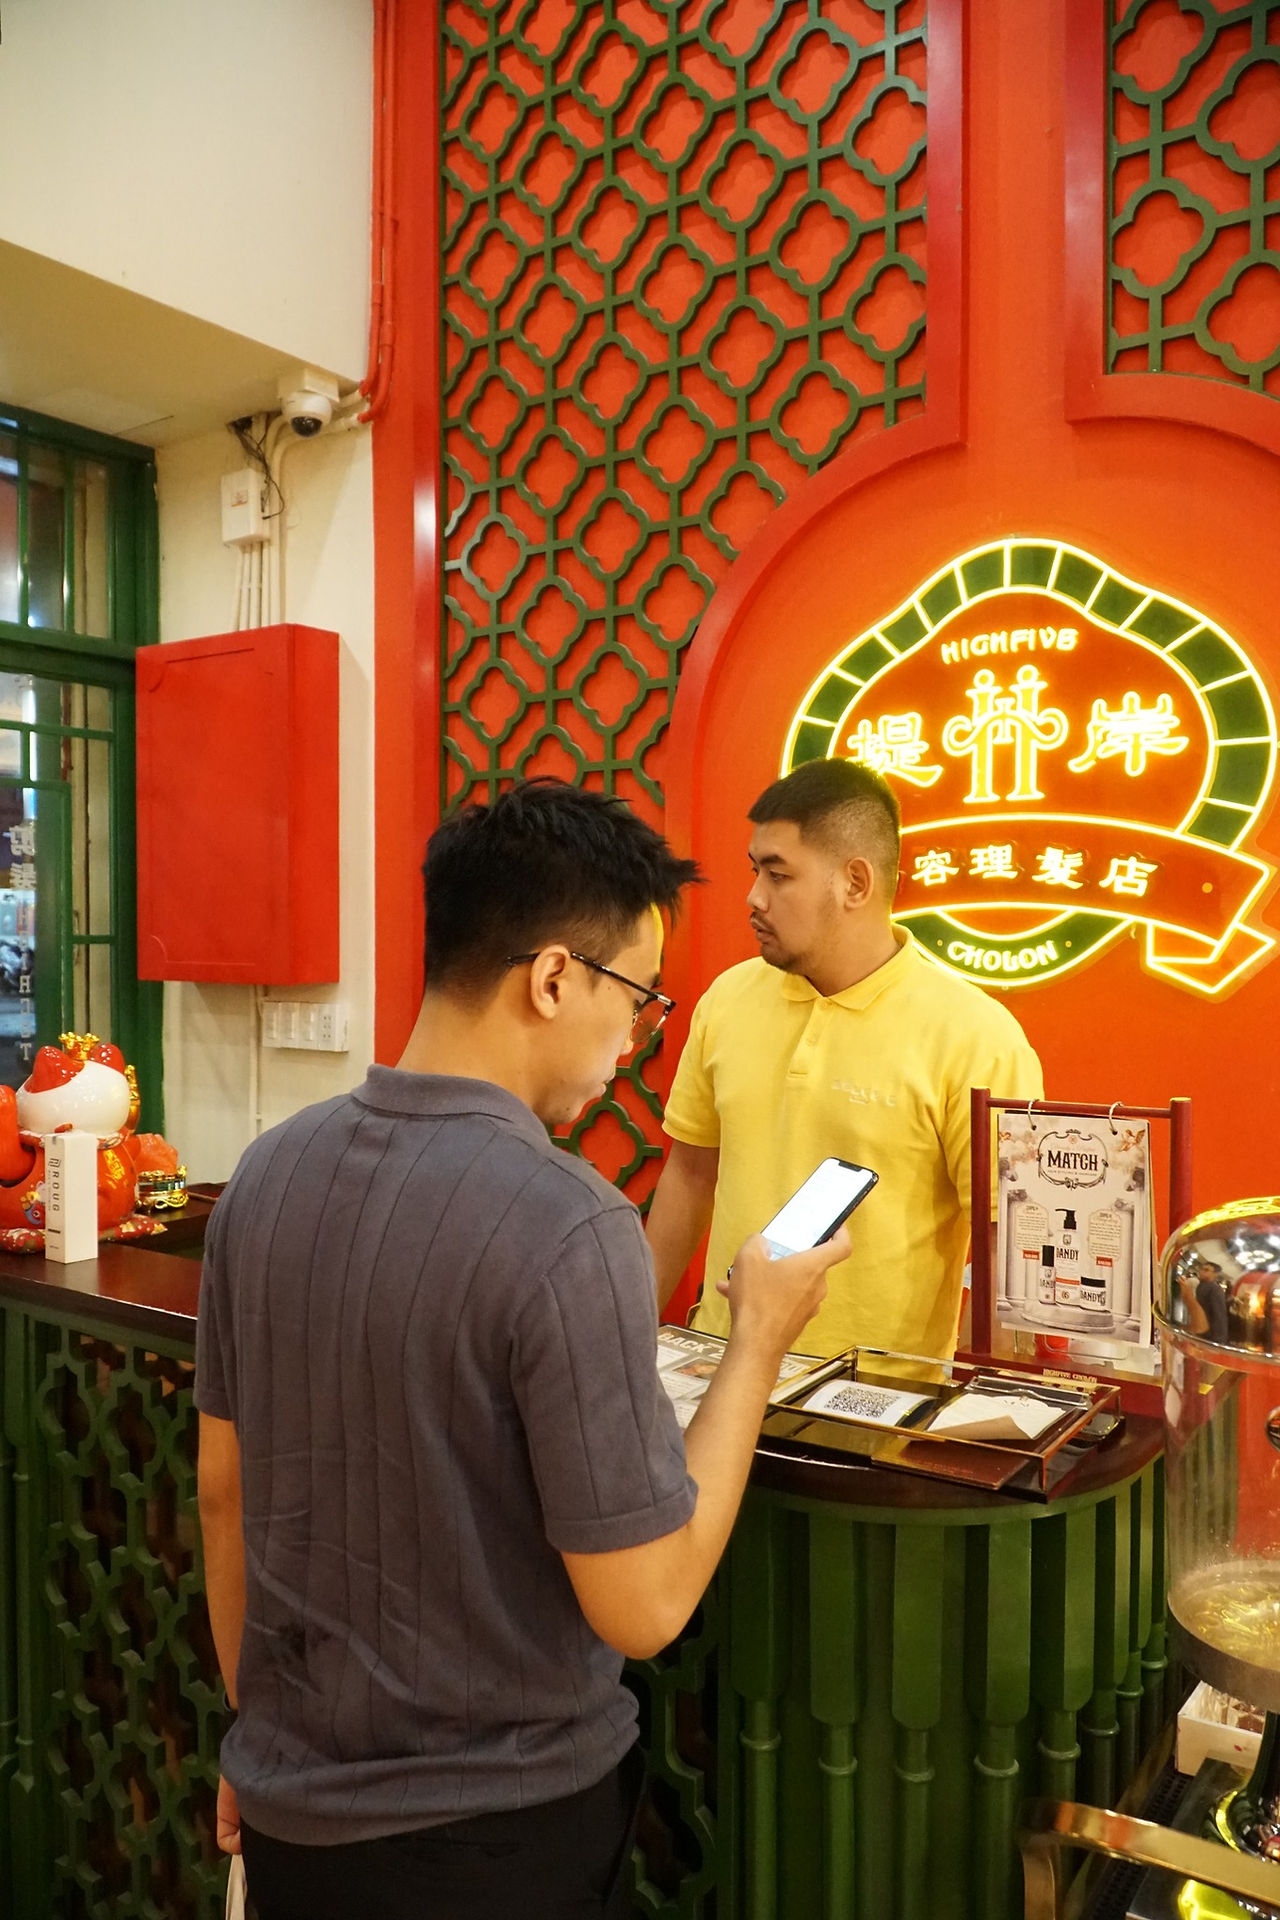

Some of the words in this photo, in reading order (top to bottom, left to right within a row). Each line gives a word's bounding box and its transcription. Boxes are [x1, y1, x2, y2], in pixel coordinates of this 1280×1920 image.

[941, 627, 1079, 664] HIGHFIVE
[947, 940, 1059, 973] CHOLON
[1047, 1150, 1098, 1171] MATCH
[657, 1332, 710, 1353] BACK
